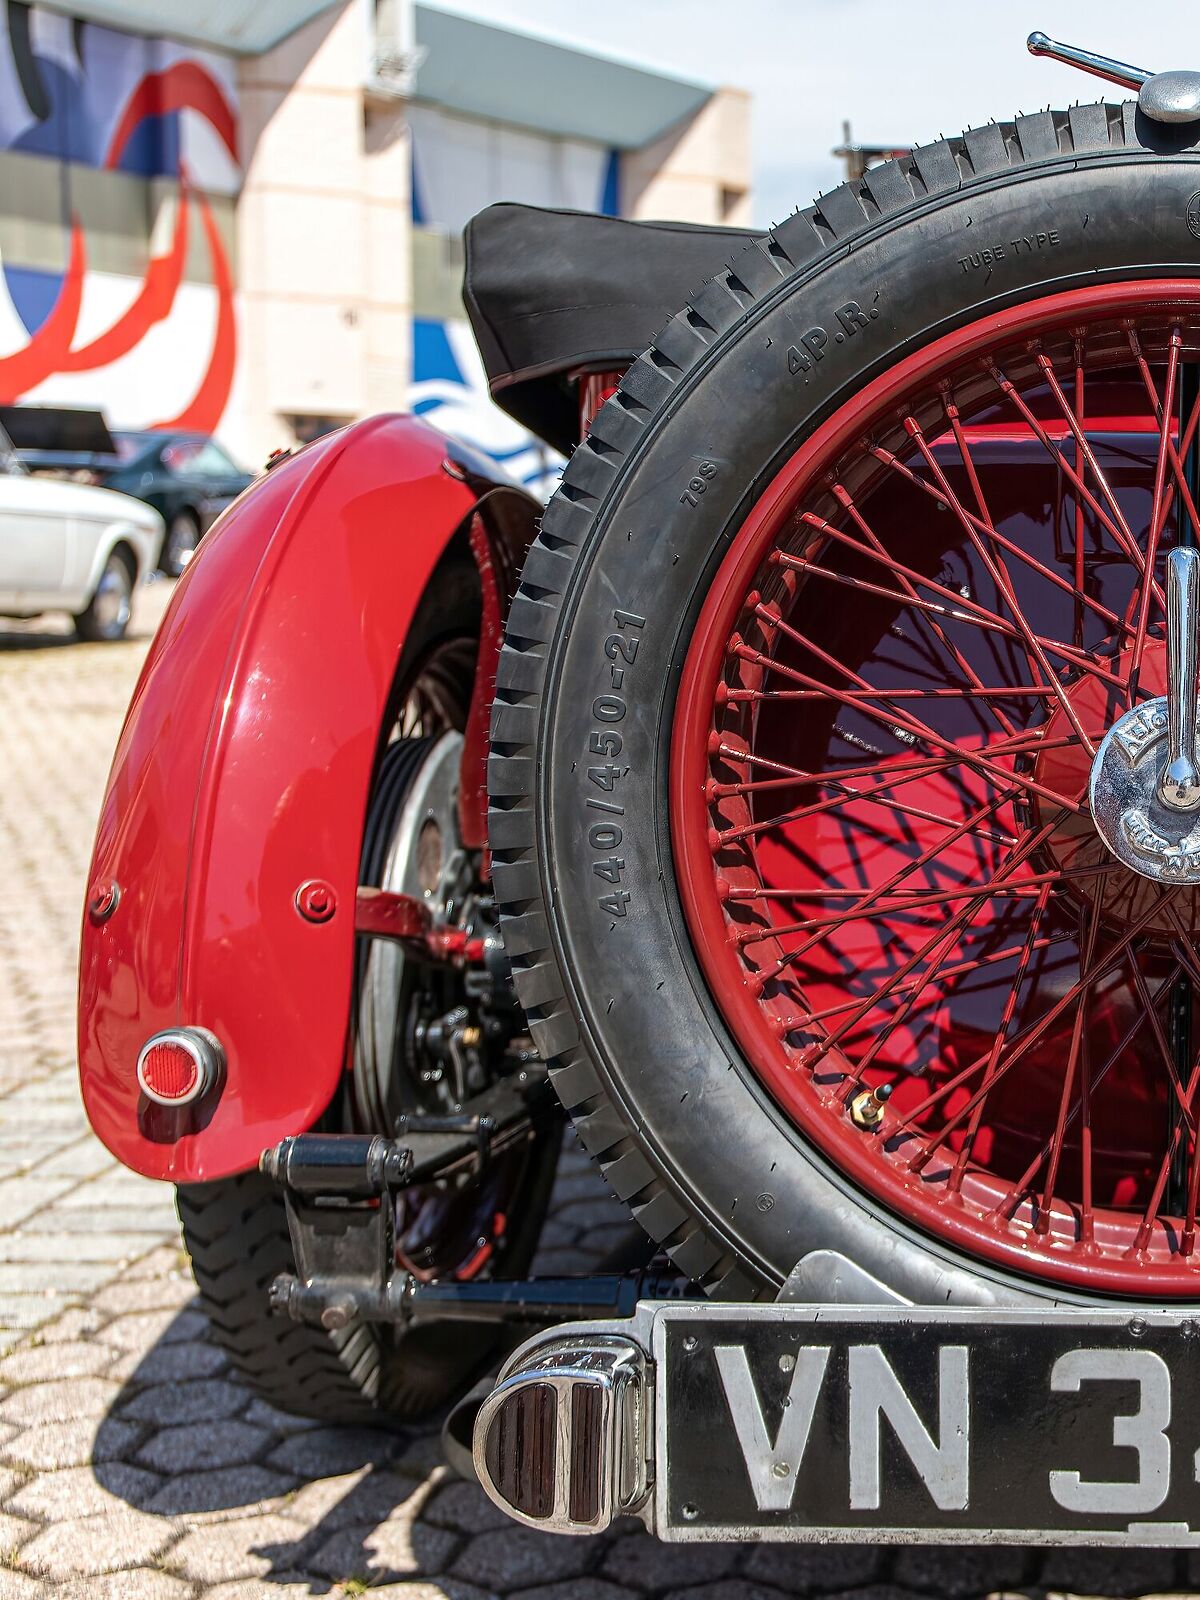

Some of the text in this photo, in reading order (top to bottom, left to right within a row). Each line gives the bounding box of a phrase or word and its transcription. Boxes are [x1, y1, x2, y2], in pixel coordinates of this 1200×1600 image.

[957, 228, 1061, 275] TUBE TYPE
[679, 460, 718, 509] 79S
[1117, 704, 1168, 758] Asto
[585, 608, 647, 917] 440/450-21
[714, 1343, 970, 1512] VN
